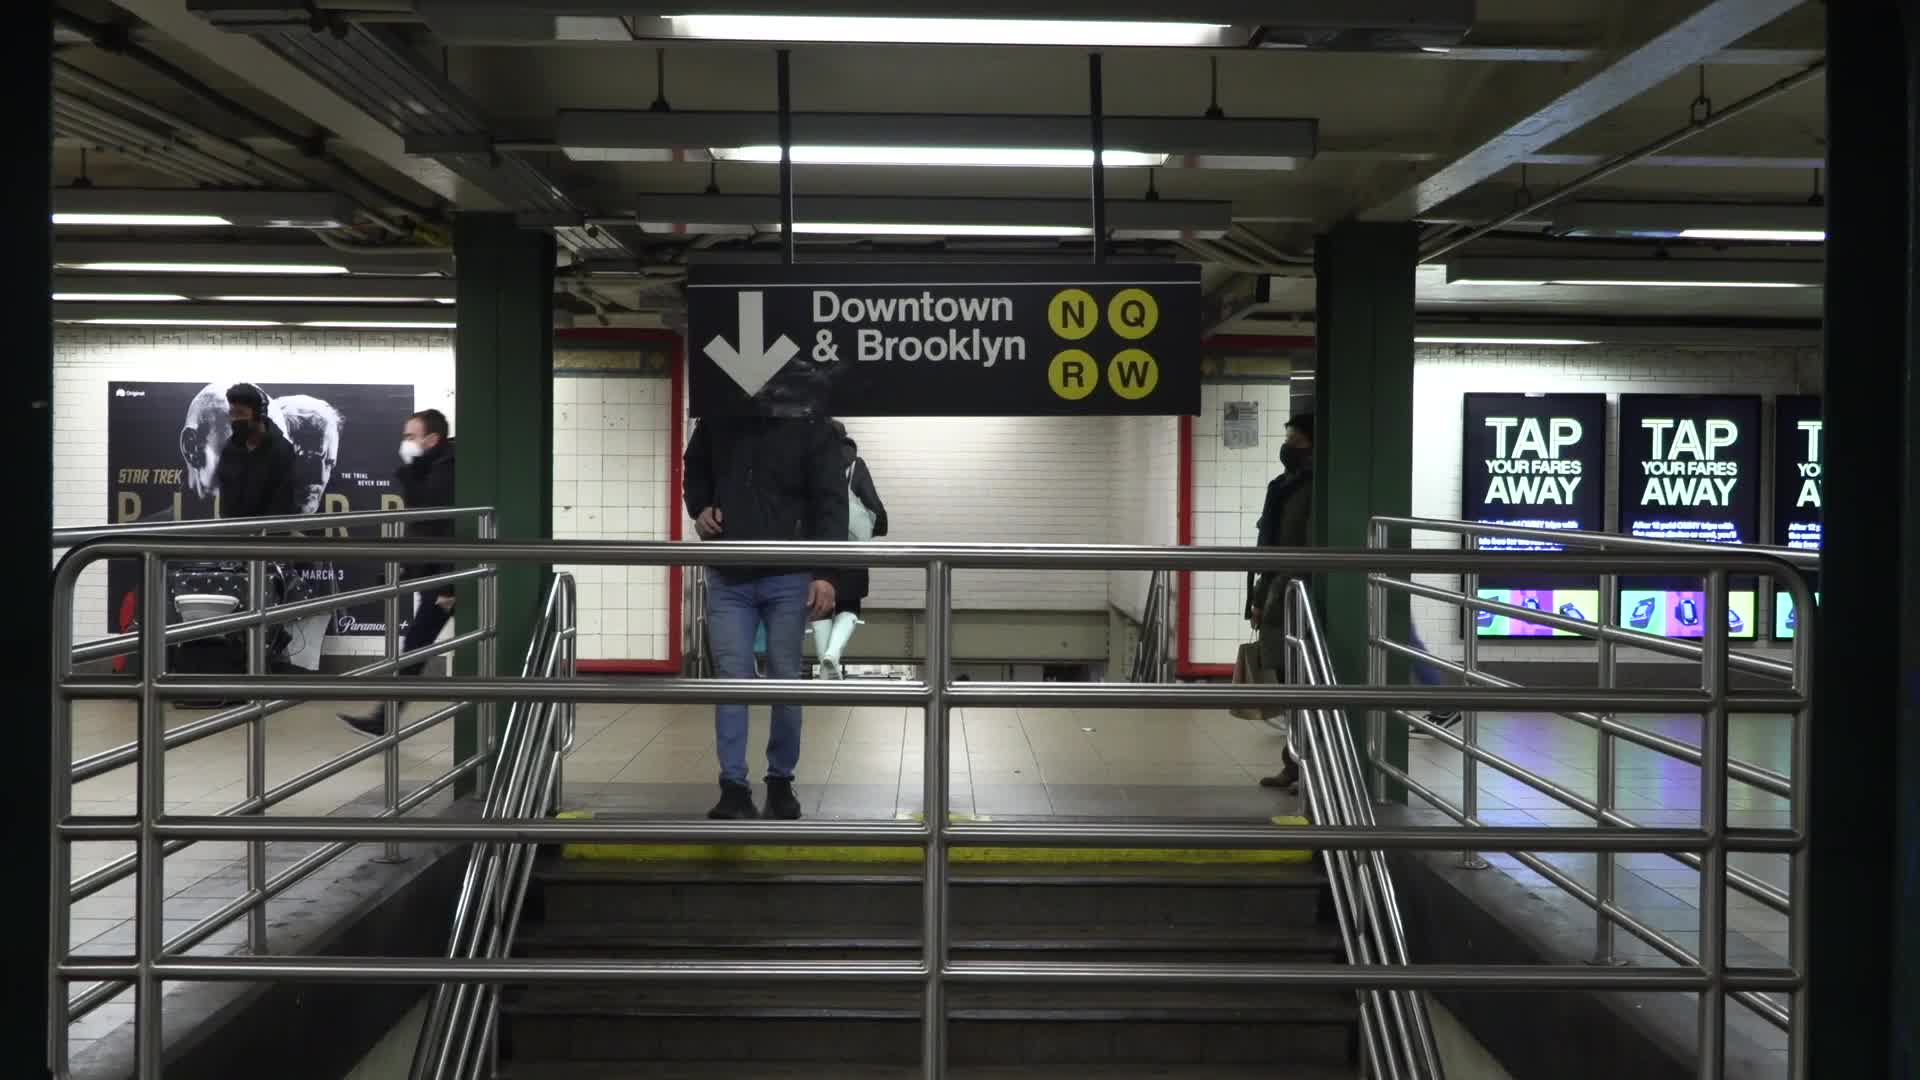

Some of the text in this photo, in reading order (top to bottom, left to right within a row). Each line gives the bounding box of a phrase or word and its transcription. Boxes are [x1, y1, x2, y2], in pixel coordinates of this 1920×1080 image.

[812, 290, 1013, 323] Downtown
[1061, 299, 1146, 329] N Q
[811, 328, 1026, 368] & Brooklyn
[1062, 361, 1150, 388] R W
[1485, 417, 1583, 460] TAP
[1641, 419, 1738, 461] TAP
[118, 469, 183, 485] STAR TREK
[1485, 459, 1582, 475] YOUR FARES
[1641, 461, 1738, 476] YOUR FARES
[1797, 463, 1821, 477] YO
[1484, 476, 1582, 505] AWAY
[1640, 477, 1738, 506] AWAY
[301, 569, 345, 581] MARCH 3
